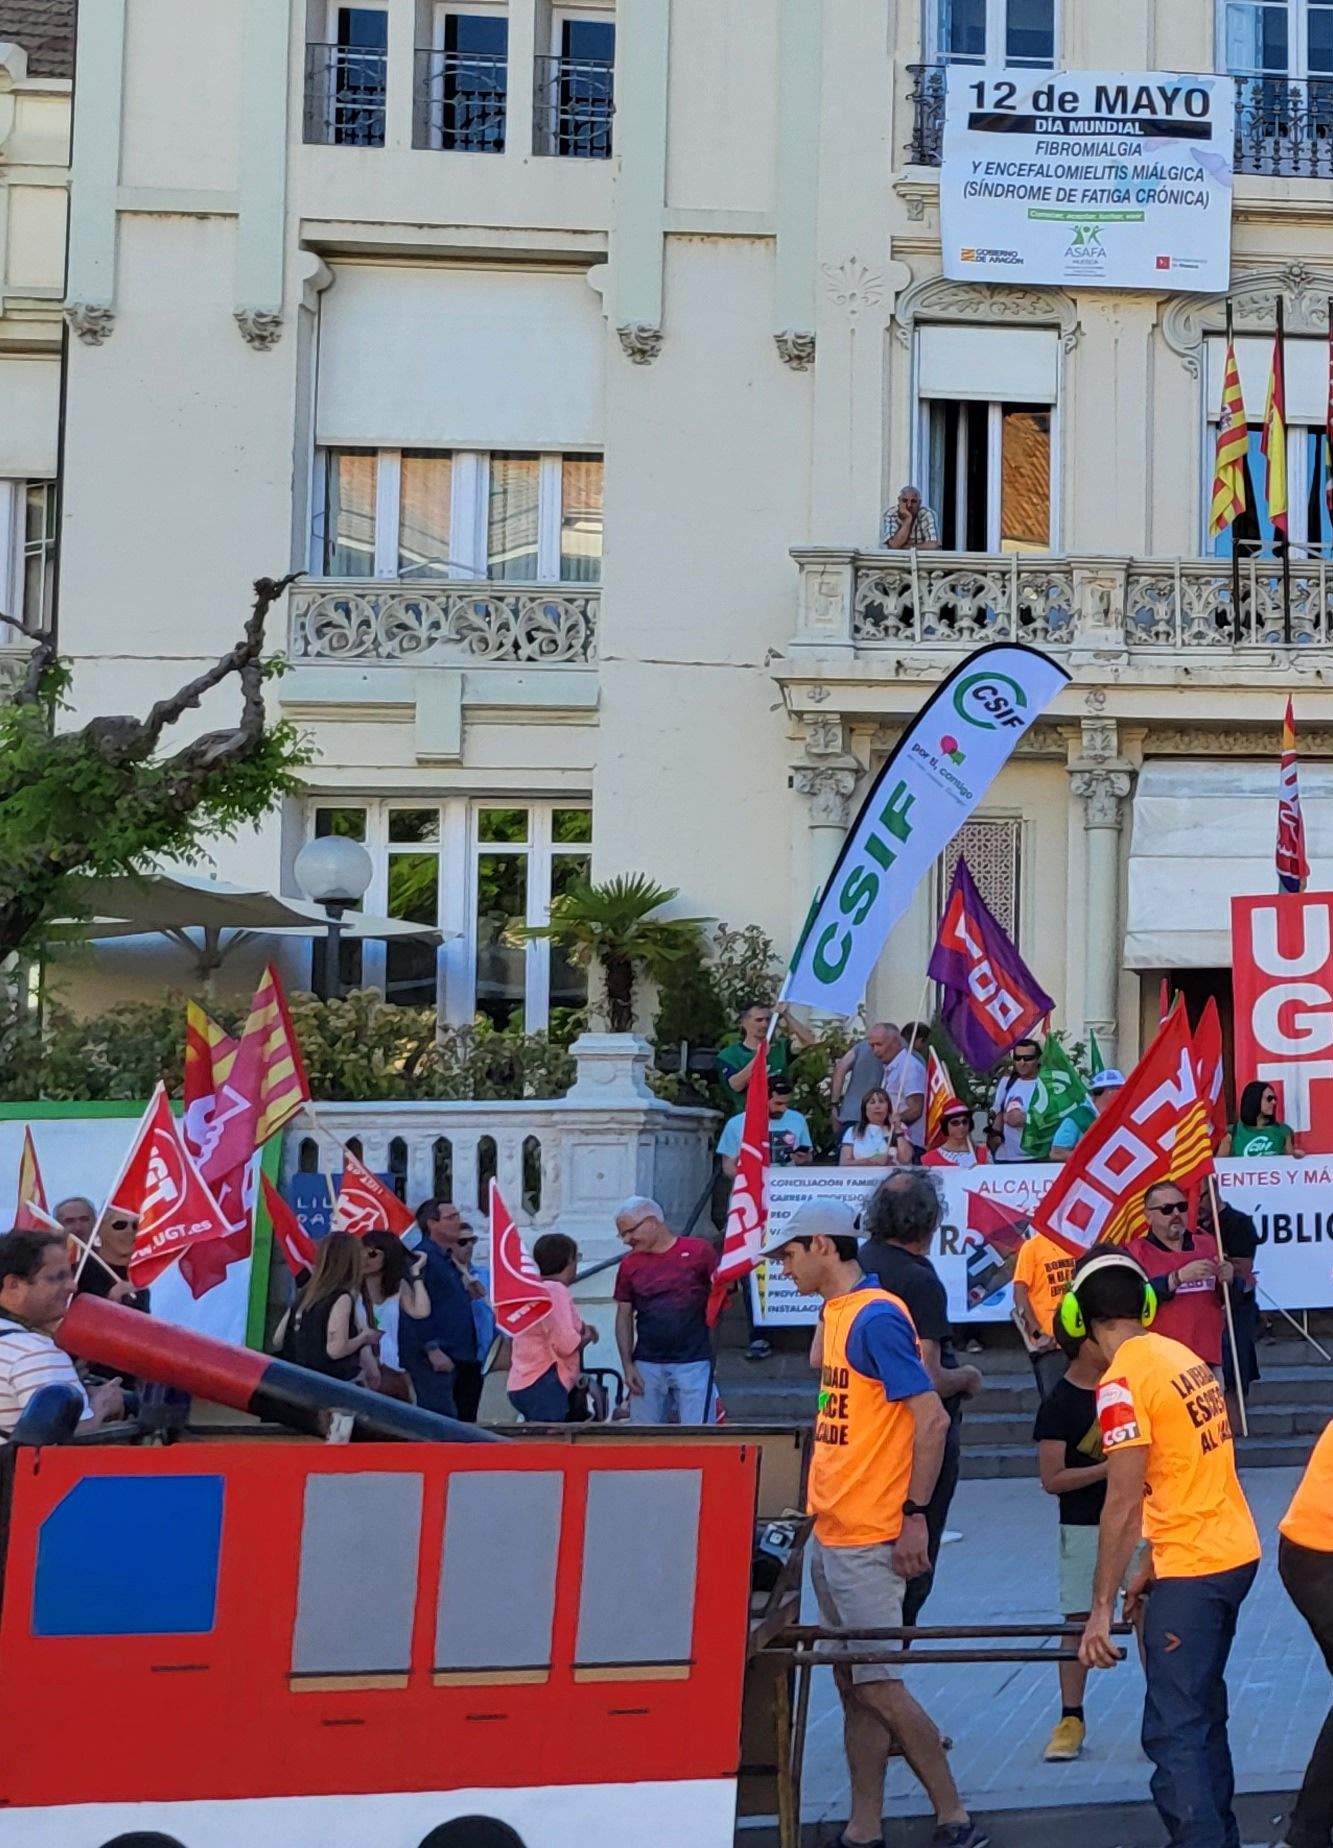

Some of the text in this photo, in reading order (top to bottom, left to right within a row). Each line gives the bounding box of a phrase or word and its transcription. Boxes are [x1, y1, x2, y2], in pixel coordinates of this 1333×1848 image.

[969, 80, 1211, 118] 12 de MAYO
[1035, 117, 1144, 135] DÍA MUNDIAL
[1035, 140, 1142, 157] FIBROMIALGIA
[971, 161, 1205, 182] Y ENCEFALOMIELITIS MIÁLGICA
[963, 180, 1210, 210] (SÍNDROME DE FATIGA CRÓNICA)
[972, 684, 1026, 730] CSIF
[812, 779, 917, 985] CSIF
[1287, 1170, 1299, 1185] Y
[1171, 1373, 1196, 1400] LA
[1103, 1421, 1138, 1447] CGT
